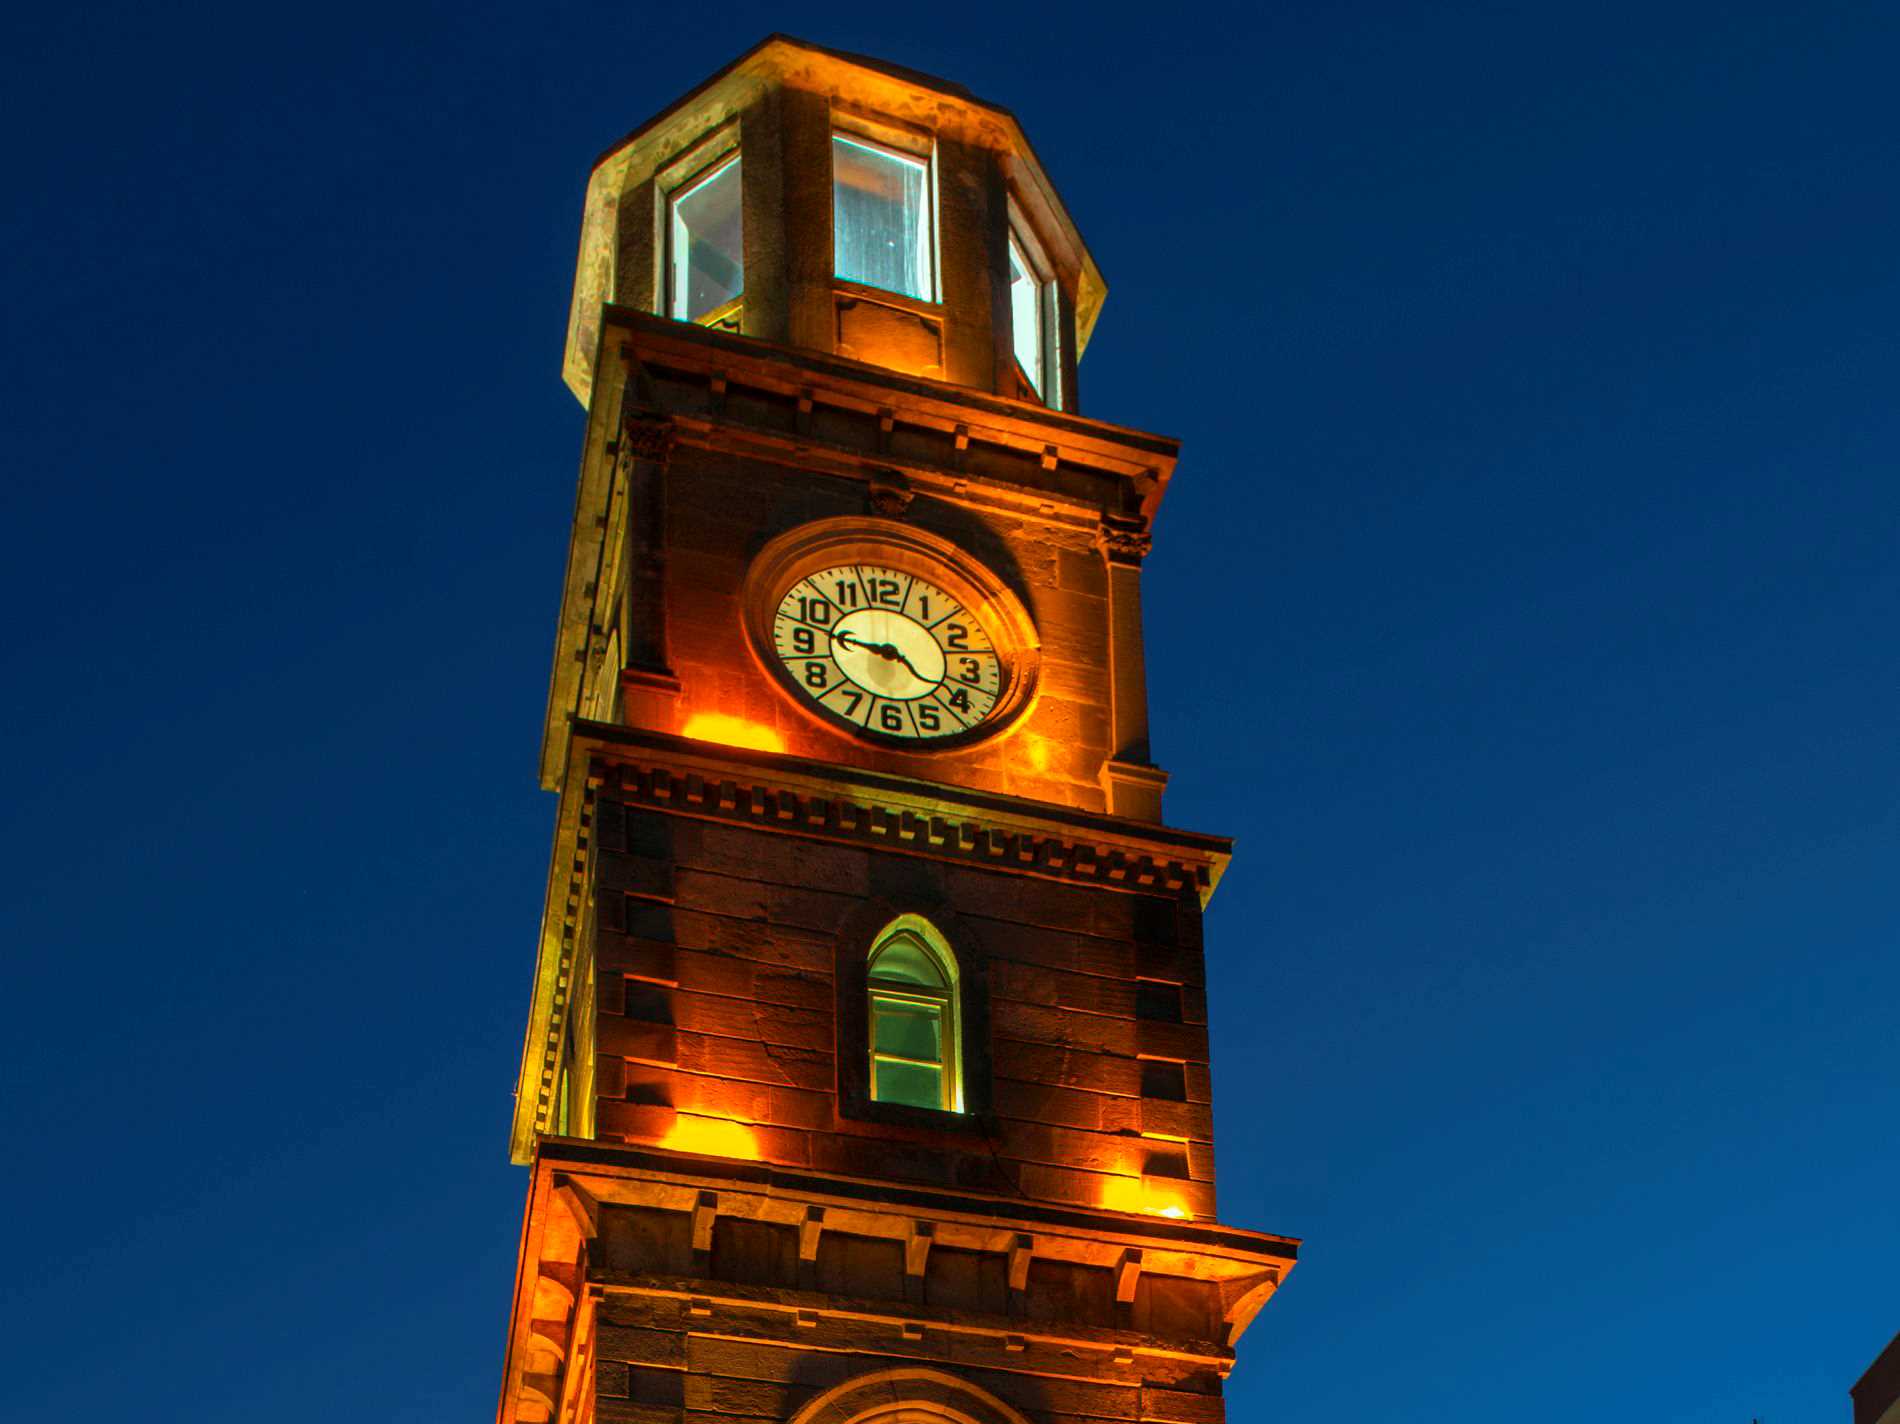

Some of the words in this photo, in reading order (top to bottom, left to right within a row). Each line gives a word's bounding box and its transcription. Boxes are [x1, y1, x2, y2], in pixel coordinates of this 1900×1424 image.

[835, 579, 857, 607] 11
[867, 577, 900, 606] 12
[798, 596, 830, 625] 10
[919, 595, 929, 620] 1
[793, 626, 815, 654] 9
[947, 623, 968, 650] 2
[805, 661, 827, 688] 8
[959, 657, 981, 684] 3
[842, 690, 863, 716] 7
[949, 688, 971, 714] 4
[880, 704, 902, 731] 6
[919, 703, 940, 731] 5
